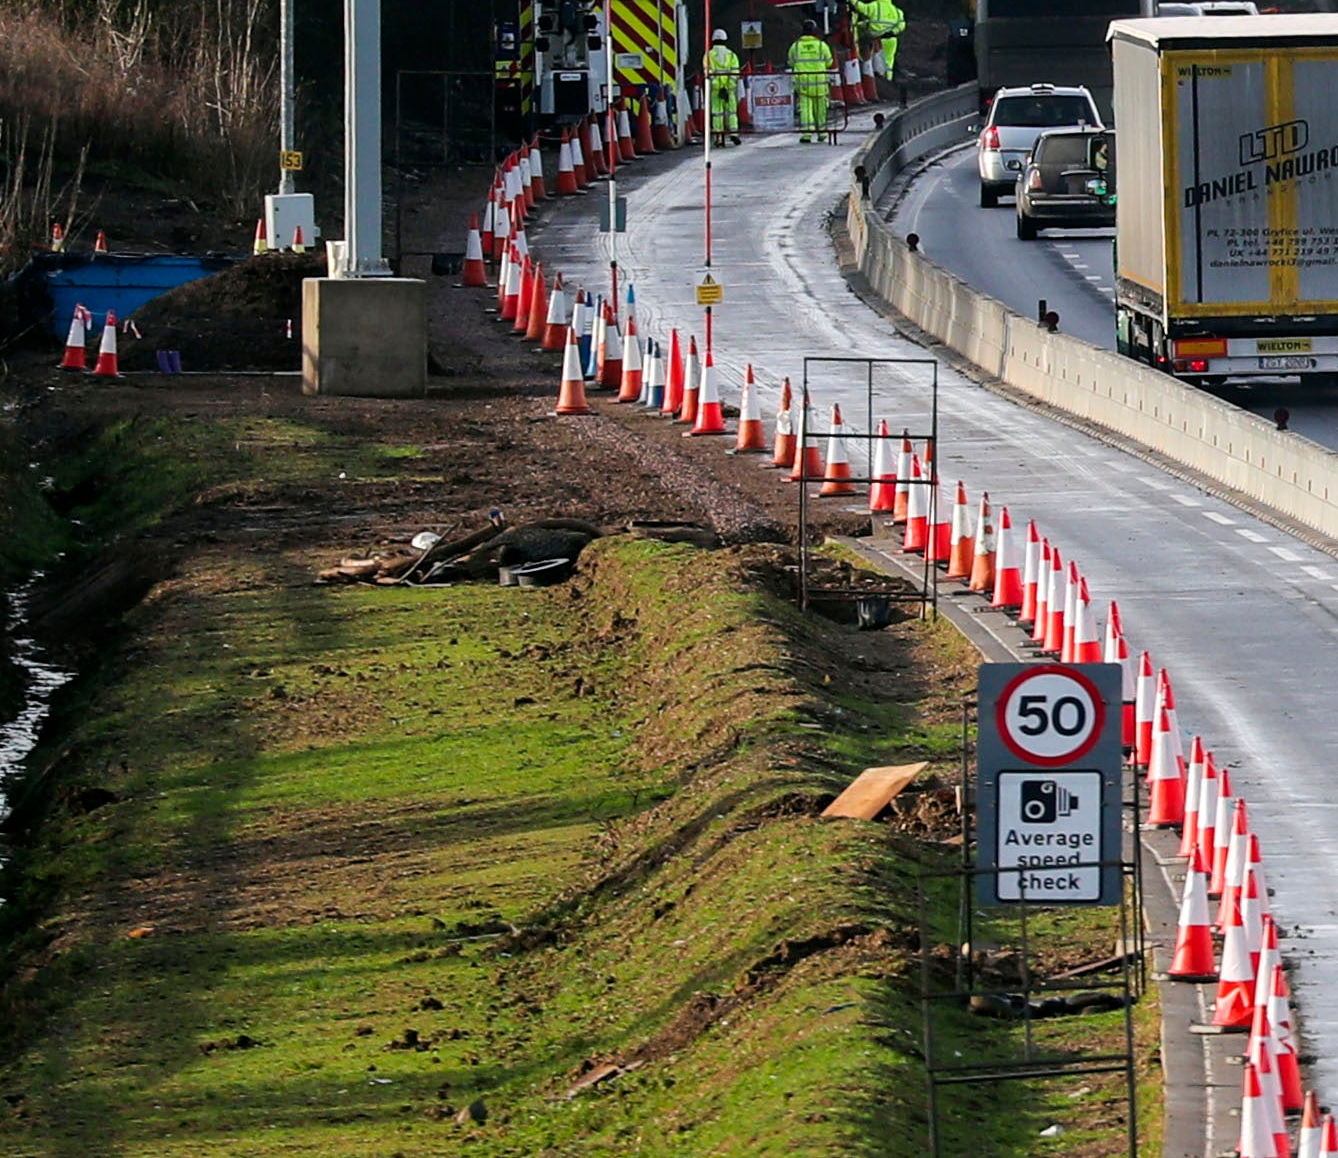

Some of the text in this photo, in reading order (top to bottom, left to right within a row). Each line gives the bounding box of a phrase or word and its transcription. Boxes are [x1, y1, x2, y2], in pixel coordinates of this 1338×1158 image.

[1178, 66, 1222, 76] WILTON
[1239, 119, 1310, 177] LTD
[1185, 171, 1258, 208] DANIEL
[1258, 341, 1301, 351] WIELTON
[1018, 695, 1086, 736] 50
[1005, 829, 1094, 849] Average
[1017, 852, 1080, 869] speed
[1017, 872, 1080, 890] check
